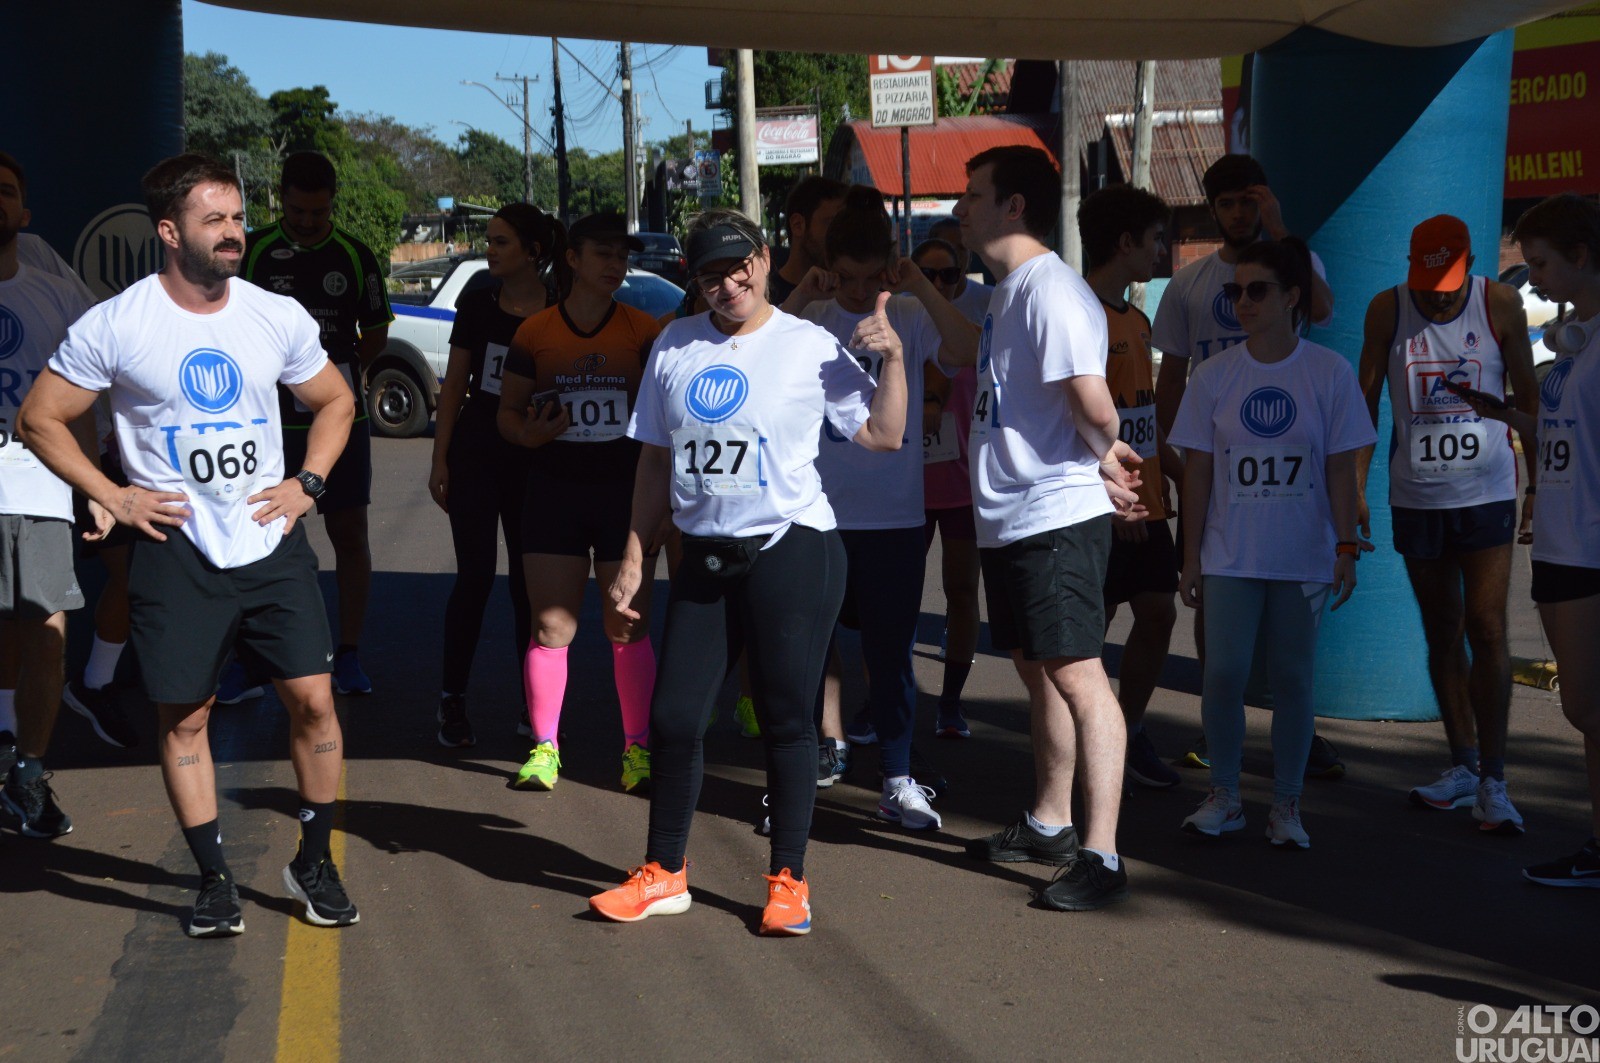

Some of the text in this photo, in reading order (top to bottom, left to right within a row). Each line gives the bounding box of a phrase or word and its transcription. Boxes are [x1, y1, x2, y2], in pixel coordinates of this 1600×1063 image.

[873, 76, 929, 90] RESTAURANTE
[877, 91, 928, 105] E PIZZARIA
[875, 103, 931, 123] DO MAGRÃO
[1506, 150, 1584, 182] HALEN!
[555, 374, 626, 385] Med Forma
[565, 400, 621, 427] 101
[1120, 416, 1154, 445] 086
[684, 440, 748, 474] 127
[1419, 433, 1479, 461] 109
[189, 440, 258, 484] 068
[1238, 456, 1302, 486] 017
[314, 740, 337, 754] 2021
